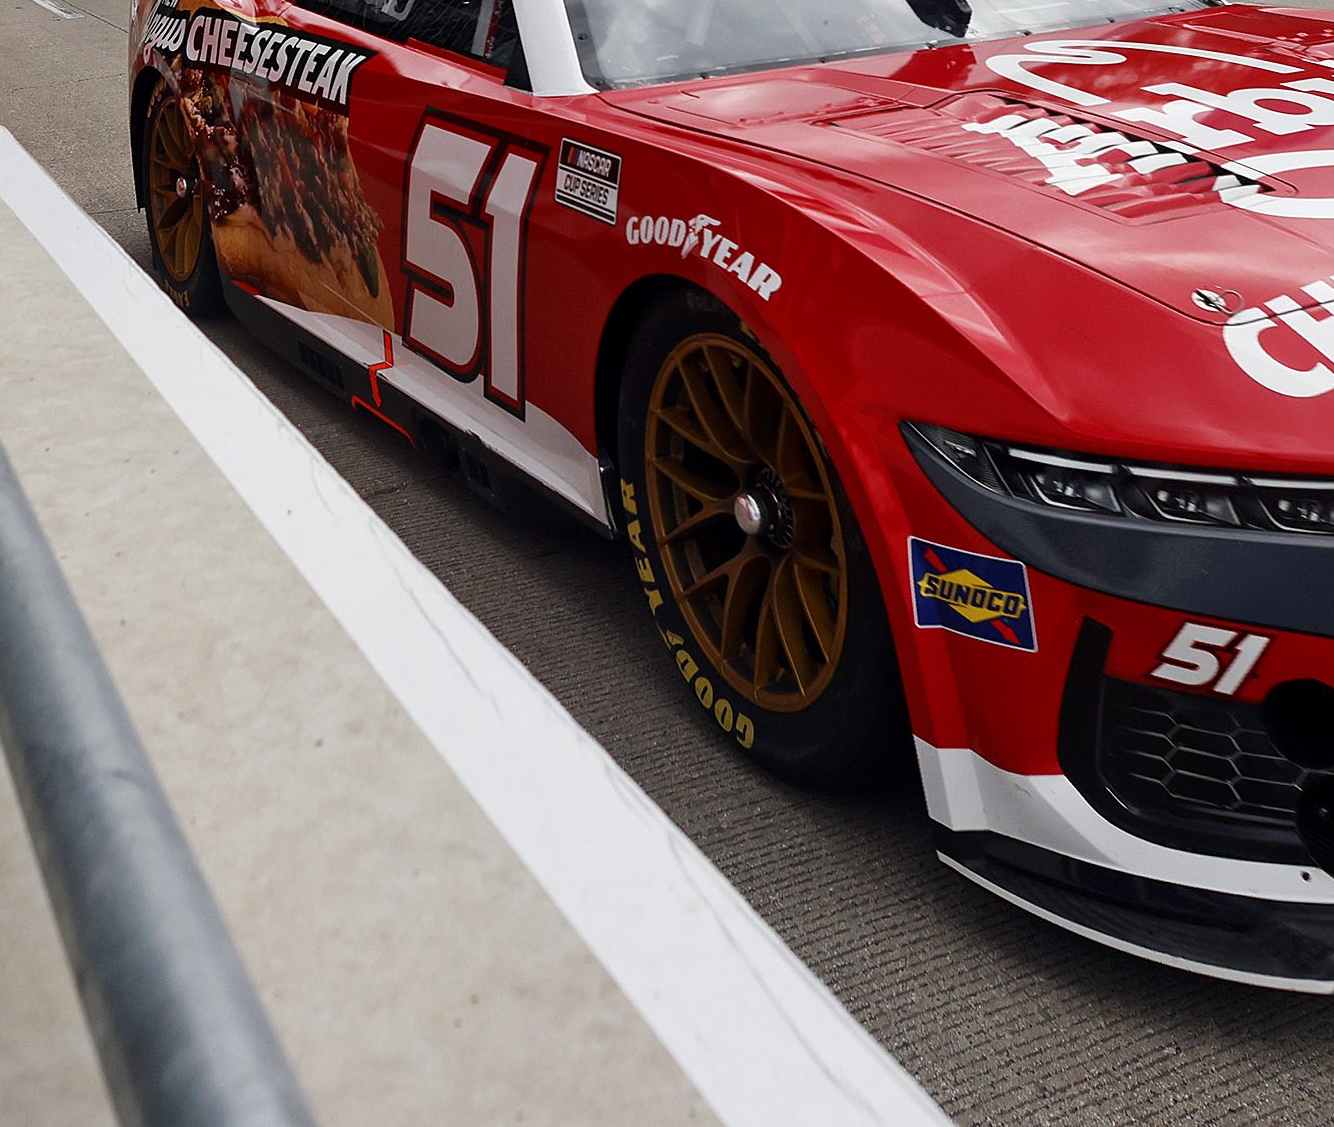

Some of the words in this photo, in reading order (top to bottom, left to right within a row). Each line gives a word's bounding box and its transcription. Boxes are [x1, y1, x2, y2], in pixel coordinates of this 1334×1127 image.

[186, 15, 366, 105] CHEESESTEAK
[563, 174, 581, 195] CUP
[580, 178, 610, 206] SERIES
[577, 149, 612, 178] NASCAR
[403, 123, 539, 402] 51
[924, 574, 1022, 616] SUNOCO
[1151, 622, 1270, 696] 51
